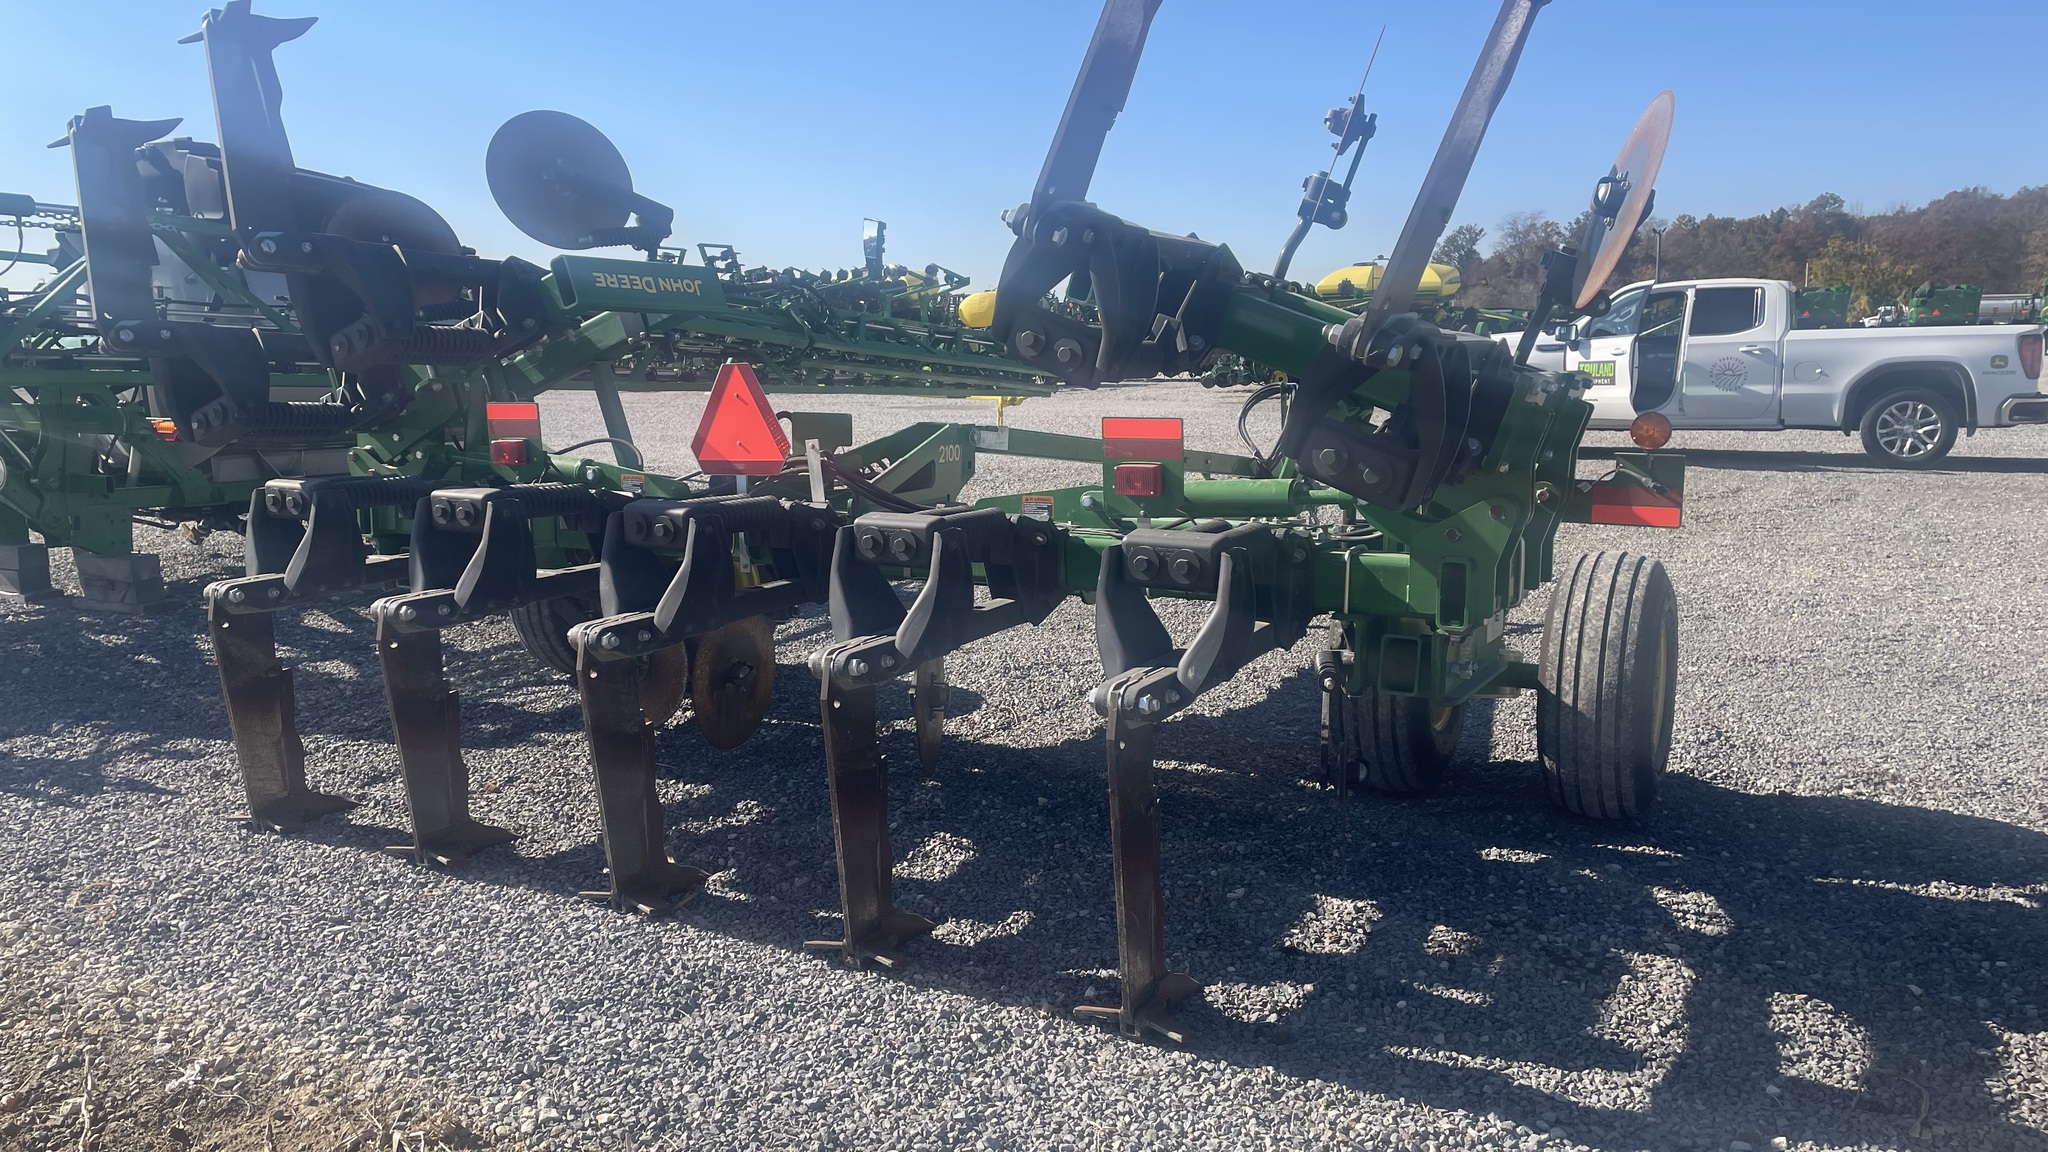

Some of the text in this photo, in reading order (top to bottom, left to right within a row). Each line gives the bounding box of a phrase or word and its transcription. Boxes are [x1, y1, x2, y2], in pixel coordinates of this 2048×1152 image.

[592, 272, 703, 296] JOHN DEERE
[938, 444, 960, 463] 2100
